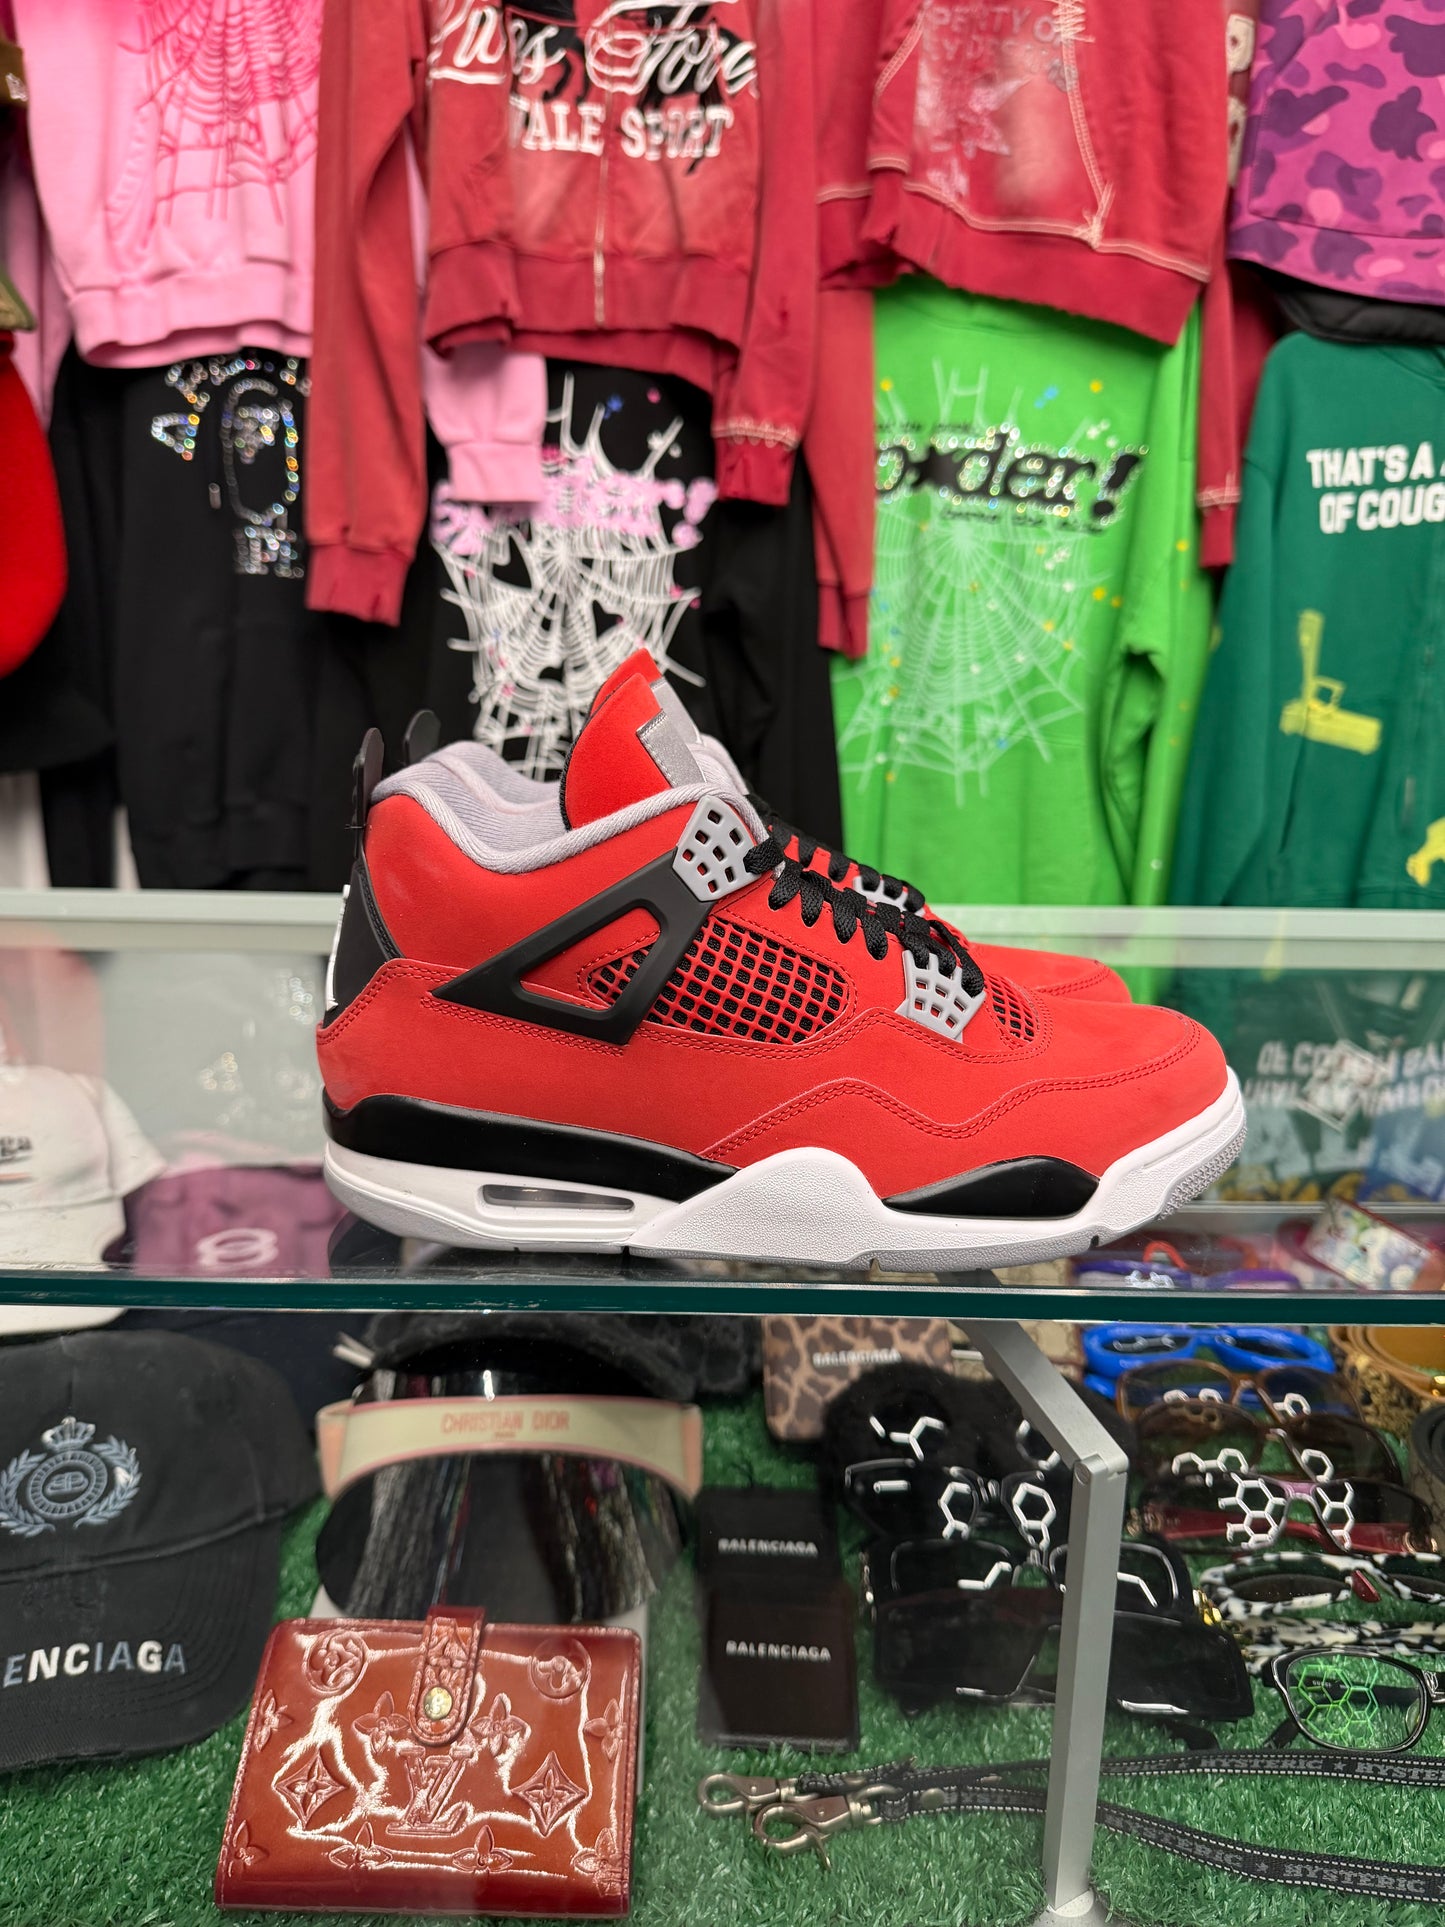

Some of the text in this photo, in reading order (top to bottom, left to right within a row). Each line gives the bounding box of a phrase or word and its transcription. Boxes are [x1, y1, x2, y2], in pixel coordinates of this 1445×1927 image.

[1306, 444, 1409, 488] THAT'S
[1409, 440, 1434, 481] A
[1319, 482, 1445, 534] OF COUG
[441, 1410, 570, 1434] CHRISTIAN DIOR
[718, 1538, 819, 1557] BALENCIAGA
[3, 1640, 187, 1688] ENCIAGA
[726, 1640, 832, 1661] BALENCIAGA
[1200, 1758, 1323, 1770] HYSTERIC
[1283, 1863, 1425, 1893] HYSTERIC
